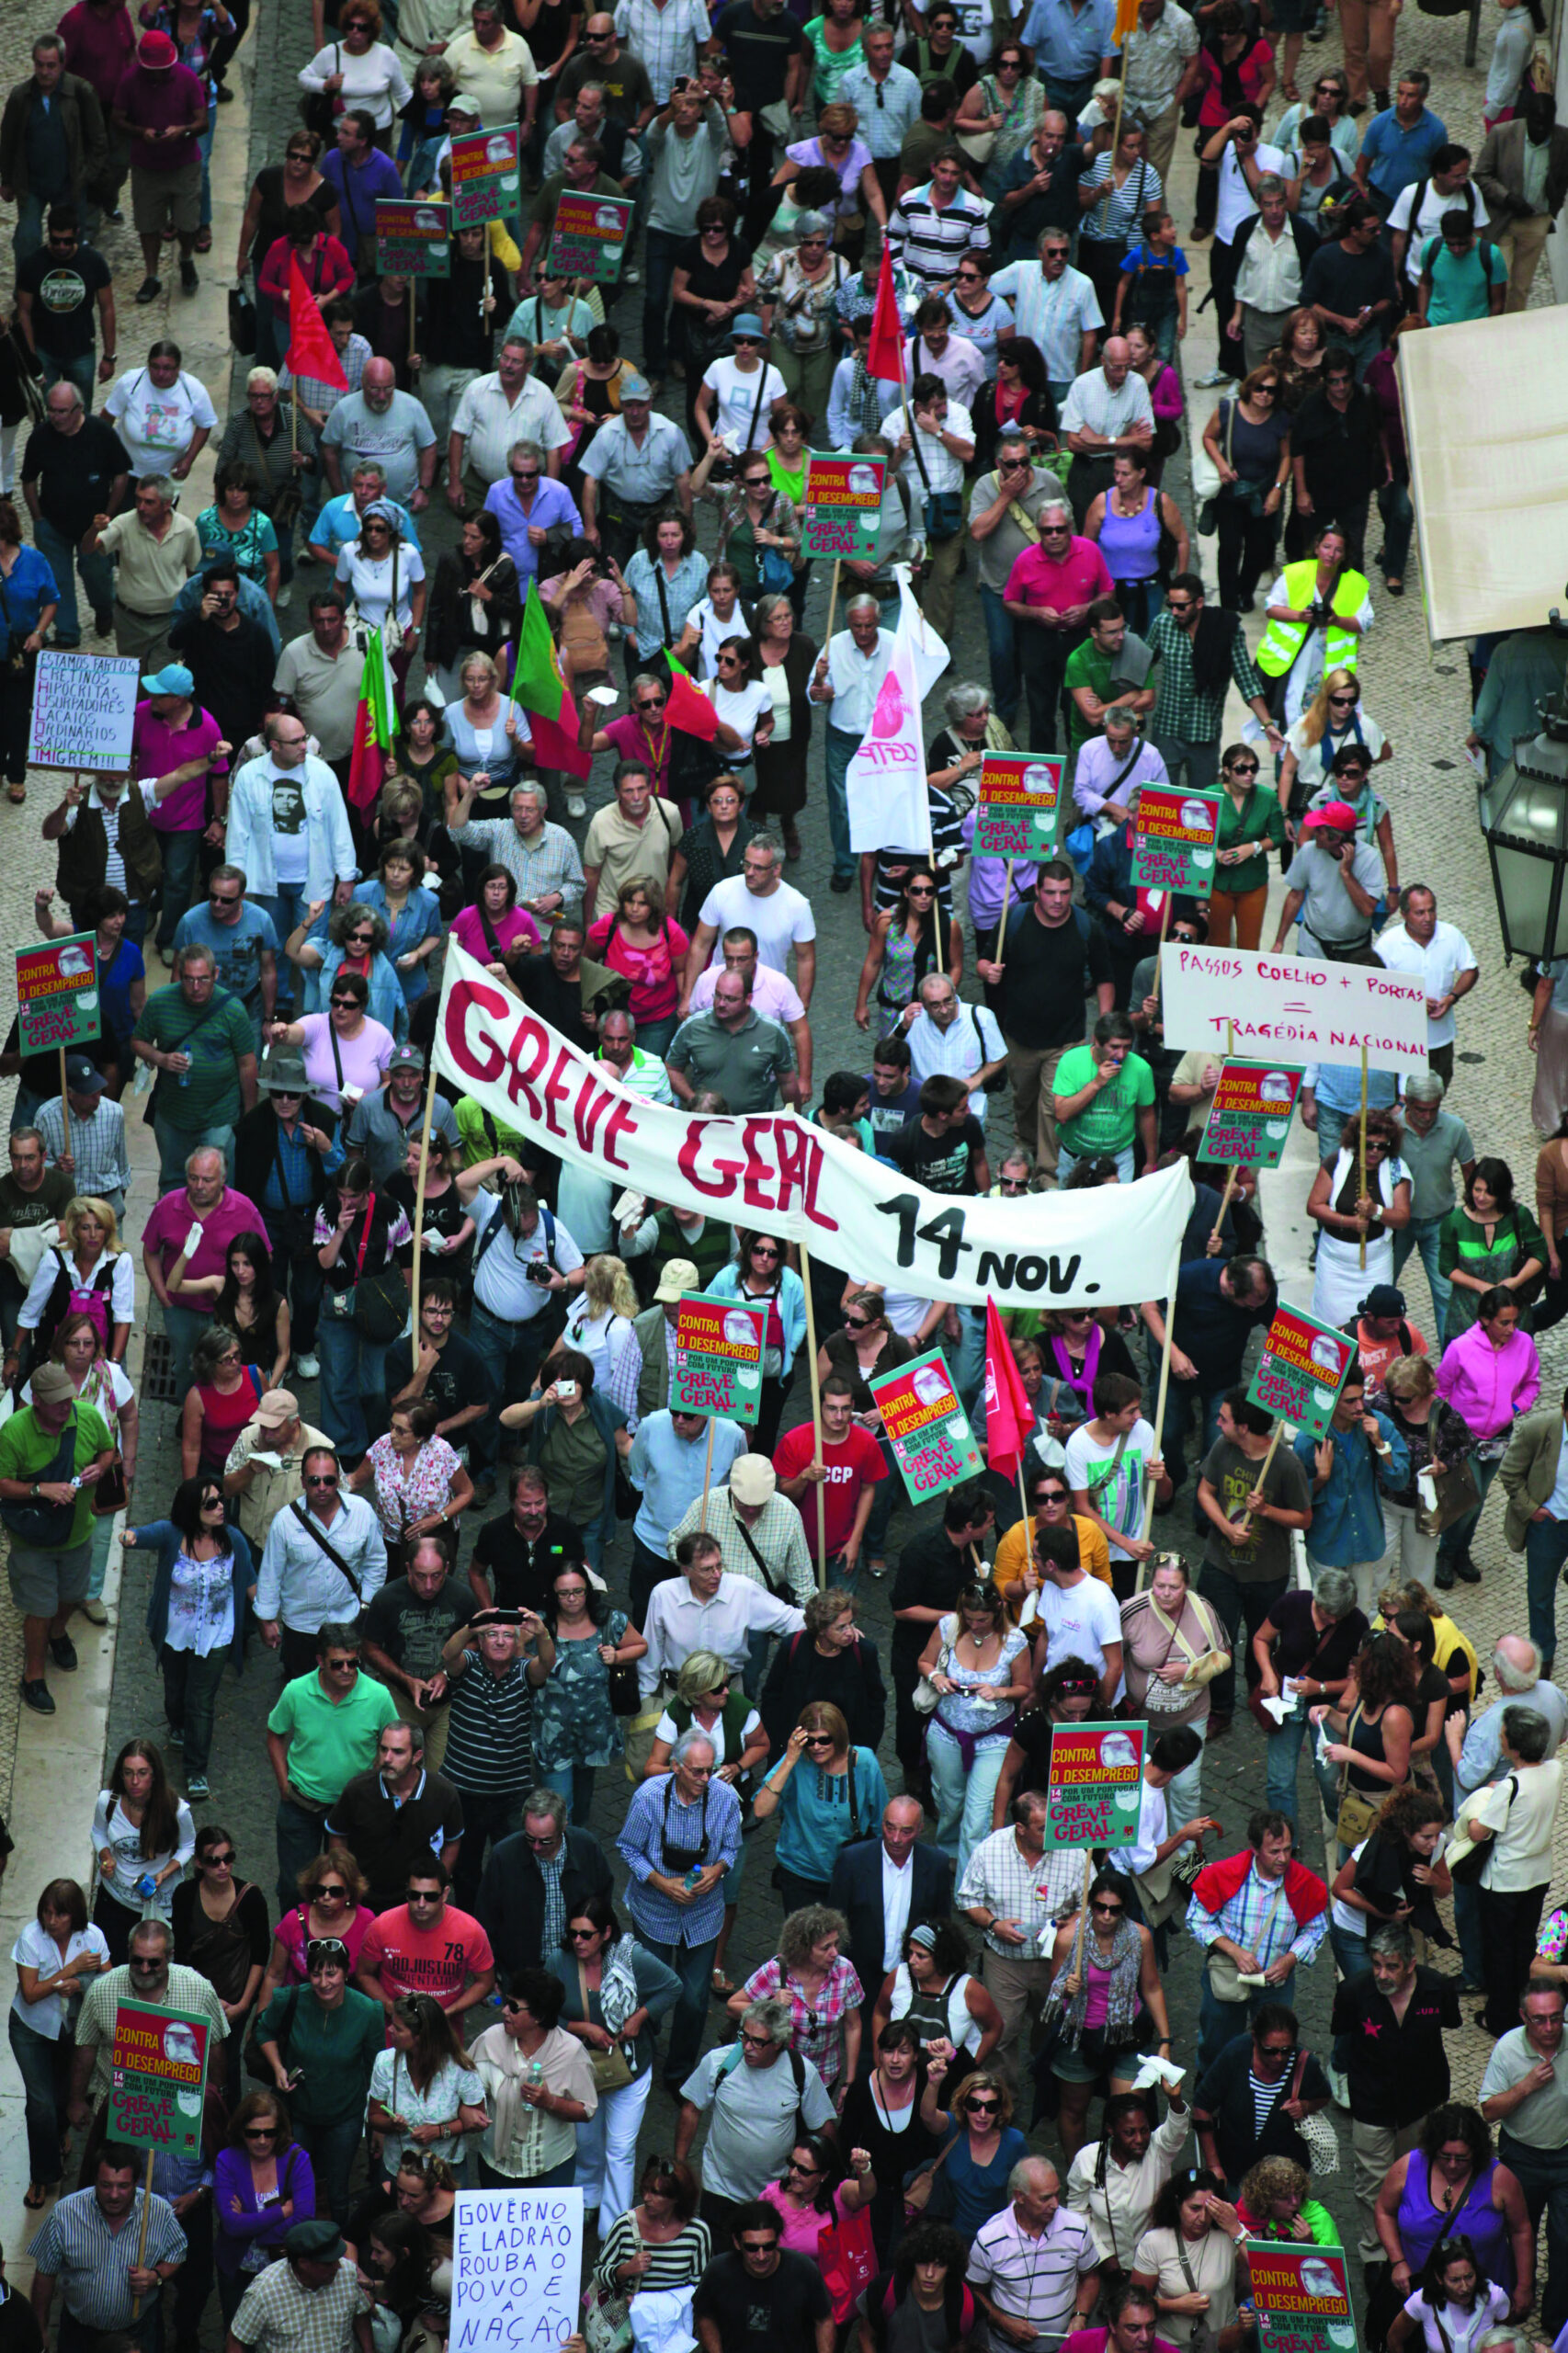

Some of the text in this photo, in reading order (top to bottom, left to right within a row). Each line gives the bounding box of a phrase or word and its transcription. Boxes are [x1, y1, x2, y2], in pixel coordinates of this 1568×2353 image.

[452, 151, 483, 167] CONTRA
[453, 158, 517, 181] O DESEMPREGO
[455, 186, 500, 209] GREVE
[460, 200, 503, 222] GERAL
[559, 208, 592, 220] CONTRA
[555, 221, 623, 241] O DESEMPREGO
[552, 244, 601, 261] GREVE
[554, 259, 600, 275] GERAL
[810, 474, 846, 486] CONTRA
[808, 491, 880, 506] O DESEMPREGO
[806, 521, 858, 538] GREVE
[810, 536, 859, 553] GERAL
[40, 653, 89, 669] ESTAMOS
[40, 666, 109, 685] CRETINOS
[38, 694, 125, 713] USURPADORES
[37, 708, 96, 725] LACAIOS
[36, 749, 115, 767] IMIGREM!!!
[982, 772, 1019, 786] CONTRA
[980, 790, 1056, 806] O DESEMPREGO
[1141, 803, 1177, 820] CONTRA
[978, 820, 1032, 837] GREVE
[1138, 820, 1213, 844] O DESEMPREGO
[981, 835, 1033, 854] GERAL
[1136, 850, 1190, 871] GREVE
[1139, 867, 1191, 888] GERAL
[18, 963, 55, 983] CONTRA
[1257, 961, 1326, 985] COELHO
[1367, 978, 1424, 1003] PORTAS
[19, 988, 26, 1000] O
[30, 972, 94, 997] DESEMPREGO
[22, 1004, 76, 1030] GREVE
[28, 1020, 80, 1046] GERAL
[444, 979, 638, 1171] GREVE
[1219, 1079, 1256, 1094] CONTRA
[1214, 1097, 1291, 1114] O DESEMPREGO
[1208, 1126, 1262, 1144] GREVE
[1208, 1142, 1261, 1161] GERAL
[875, 1192, 1101, 1294] 14 NOV.
[679, 1314, 720, 1334] CONTRA
[1271, 1322, 1308, 1350] CONTRA
[677, 1334, 759, 1361] O DESEMPREGO
[688, 1354, 703, 1362] POR
[721, 1359, 759, 1371] PORTUGAL
[708, 1364, 736, 1374] FUTURO
[1266, 1338, 1340, 1387] O DESEMPREGO
[676, 1369, 734, 1393] GREVE
[1257, 1369, 1310, 1404] GREVE
[681, 1387, 736, 1412] GERAL
[880, 1392, 917, 1420] CONTRA
[1257, 1386, 1307, 1421] GERAL
[888, 1394, 957, 1439] O DESEMPREGO
[903, 1412, 963, 1447] POR UM PORTUGAL
[906, 1428, 948, 1453] COM FUTURO
[903, 1436, 953, 1473] GREVE
[915, 1455, 962, 1491] GERAL
[1052, 1748, 1096, 1763] CONTRA
[1051, 1767, 1139, 1783] O DESEMPREGO
[1051, 1789, 1062, 1797] 14
[1083, 1792, 1115, 1802] FUTURO
[1096, 1785, 1140, 1793] PORTUGAL
[1051, 1801, 1113, 1824] GREVE
[1054, 1819, 1115, 1841] GERAL
[445, 1942, 463, 1962] 78
[116, 2026, 159, 2051] CONTRA
[113, 2071, 123, 2081] 14
[114, 2050, 201, 2083] O DESEMPREGO
[124, 2082, 176, 2099] COM FUTURO
[125, 2073, 201, 2096] POR UM PORTUGAL
[112, 2090, 176, 2120] GREVE
[116, 2113, 176, 2143] GERAL
[460, 2253, 565, 2278] ROUBA O
[1251, 2269, 1298, 2287] CONTRA
[458, 2276, 562, 2307] POVO E
[501, 2300, 514, 2313] A
[1255, 2292, 1347, 2314] O DESEMPREGO
[1259, 2313, 1270, 2322] 14
[1308, 2317, 1353, 2325] PORTUGAL
[459, 2306, 572, 2350] NAÇÃO
[1272, 2323, 1327, 2334] COM FUTURO
[1263, 2332, 1330, 2353] GREVE
